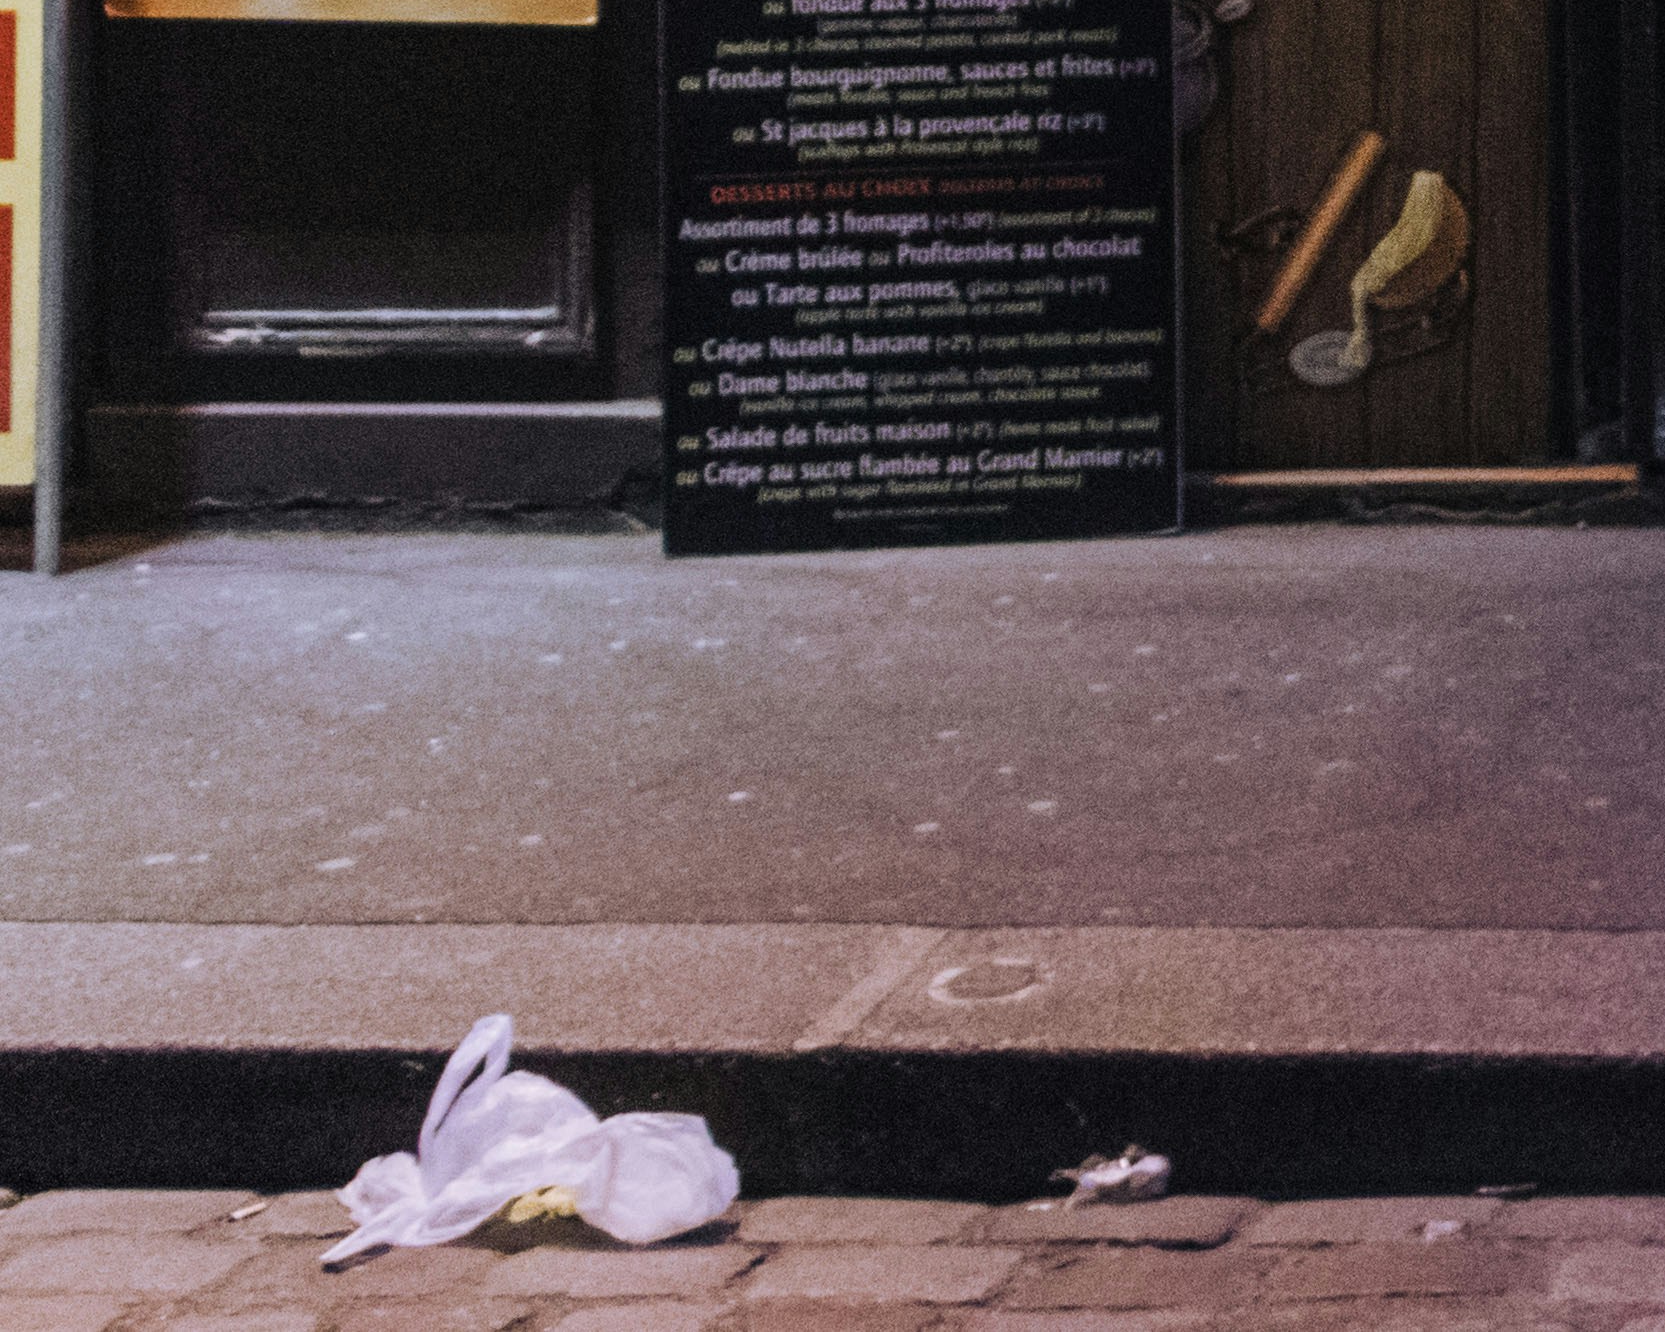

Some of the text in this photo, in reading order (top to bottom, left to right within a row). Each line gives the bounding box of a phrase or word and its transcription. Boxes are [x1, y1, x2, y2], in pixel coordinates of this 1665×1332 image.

[762, 0, 786, 15] ou
[695, 257, 720, 274] ou
[897, 240, 1015, 265] Profiteroles
[1020, 242, 1046, 260] au
[1052, 235, 1141, 260] chocolat
[675, 469, 699, 486] ou
[767, 463, 794, 483] au
[799, 460, 853, 481] sucre
[946, 454, 972, 474] au
[976, 446, 1039, 473] Grand
[1044, 446, 1123, 470] Marnier
